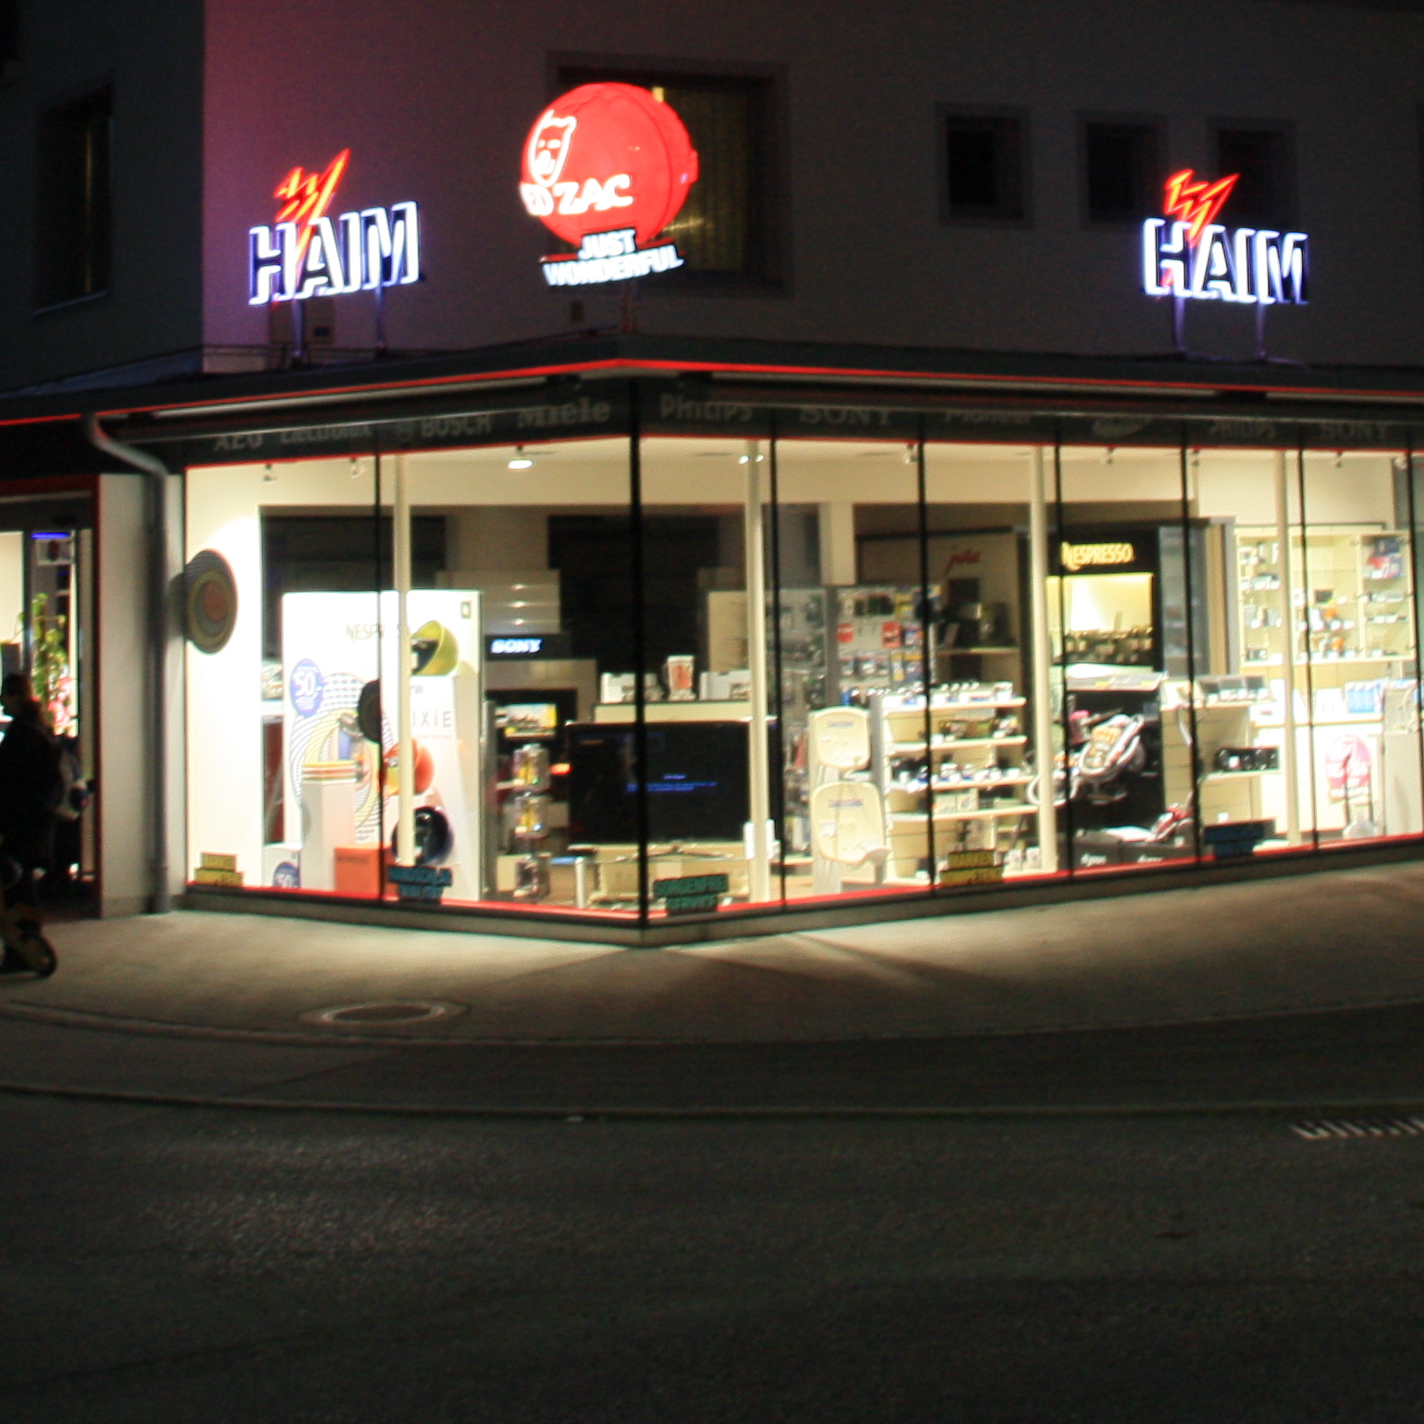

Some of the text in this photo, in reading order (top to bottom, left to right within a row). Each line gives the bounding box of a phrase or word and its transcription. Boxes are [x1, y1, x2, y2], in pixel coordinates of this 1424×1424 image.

[553, 173, 634, 215] ZAC
[248, 201, 420, 306] HAIM
[577, 228, 637, 260] JUST
[1142, 217, 1310, 305] HAIM
[542, 244, 685, 287] WONDERFUL
[1061, 541, 1136, 572] NESPRESSO
[490, 638, 543, 654] SONY
